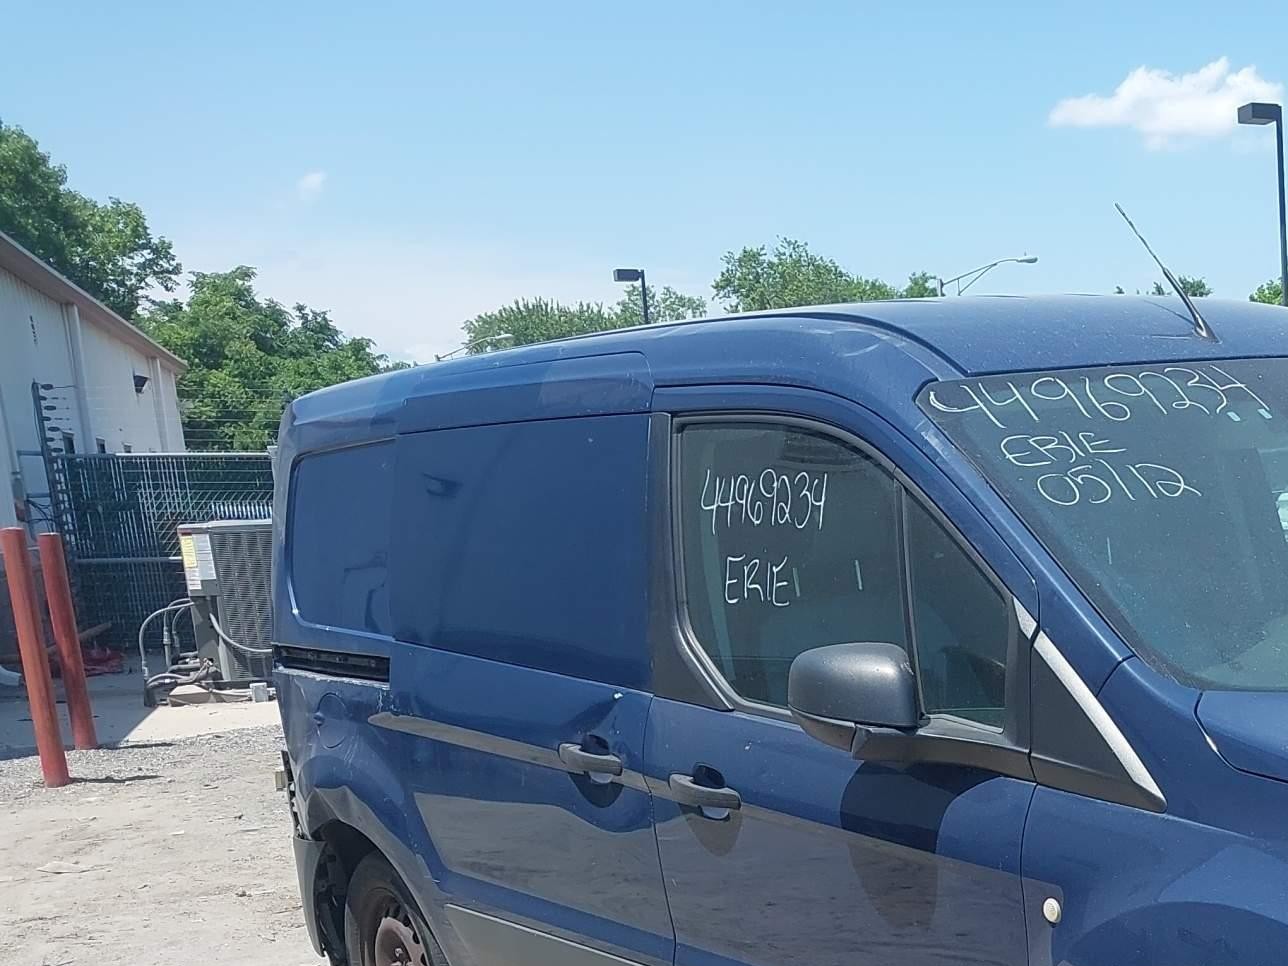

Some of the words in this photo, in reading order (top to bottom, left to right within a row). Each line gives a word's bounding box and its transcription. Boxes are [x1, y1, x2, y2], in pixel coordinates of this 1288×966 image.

[929, 365, 1271, 429] 44969234
[700, 468, 828, 535] 44969234
[725, 554, 790, 606] ERIE
